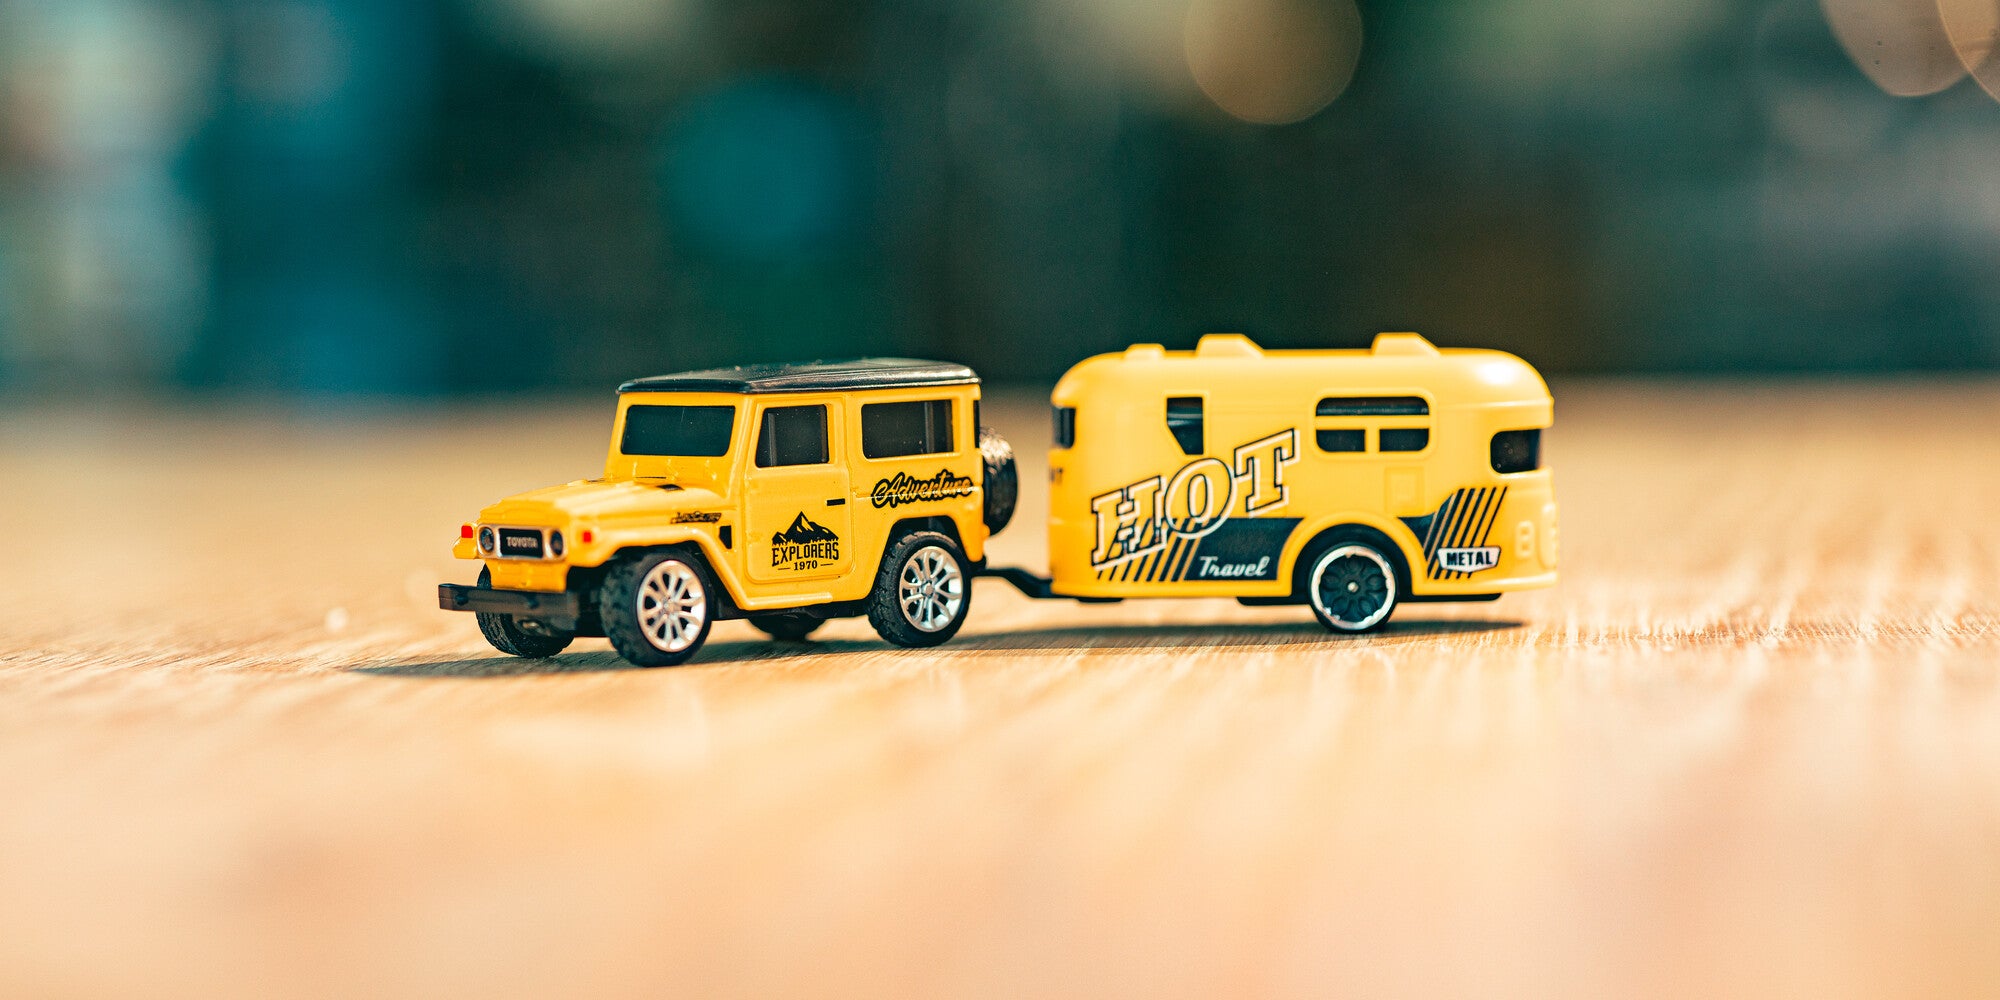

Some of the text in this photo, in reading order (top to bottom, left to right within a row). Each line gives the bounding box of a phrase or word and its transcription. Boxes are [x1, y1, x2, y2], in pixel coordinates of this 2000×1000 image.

[871, 469, 974, 508] Adventure
[1091, 427, 1300, 571] HOT
[505, 536, 538, 549] TOYOTA
[771, 541, 839, 567] EXPLORERS
[793, 559, 818, 571] 1970
[1199, 555, 1271, 578] Travel
[1446, 551, 1493, 566] METAL
